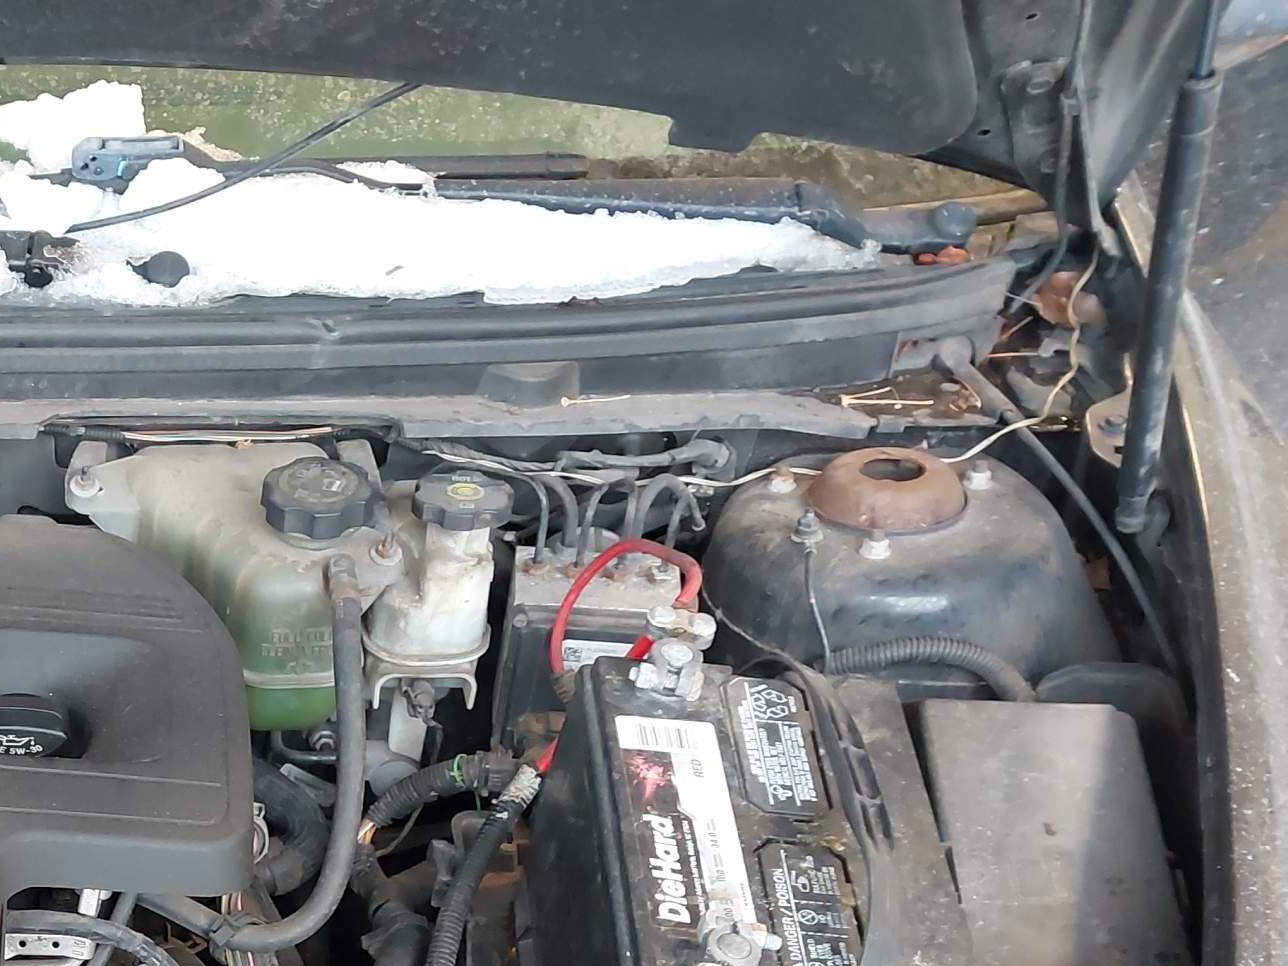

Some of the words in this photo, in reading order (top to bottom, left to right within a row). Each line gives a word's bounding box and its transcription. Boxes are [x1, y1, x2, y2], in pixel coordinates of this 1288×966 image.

[9, 745, 43, 755] 5W-30
[642, 813, 691, 924] DieHard
[772, 868, 791, 907] POISON
[782, 917, 802, 961] DANGER
